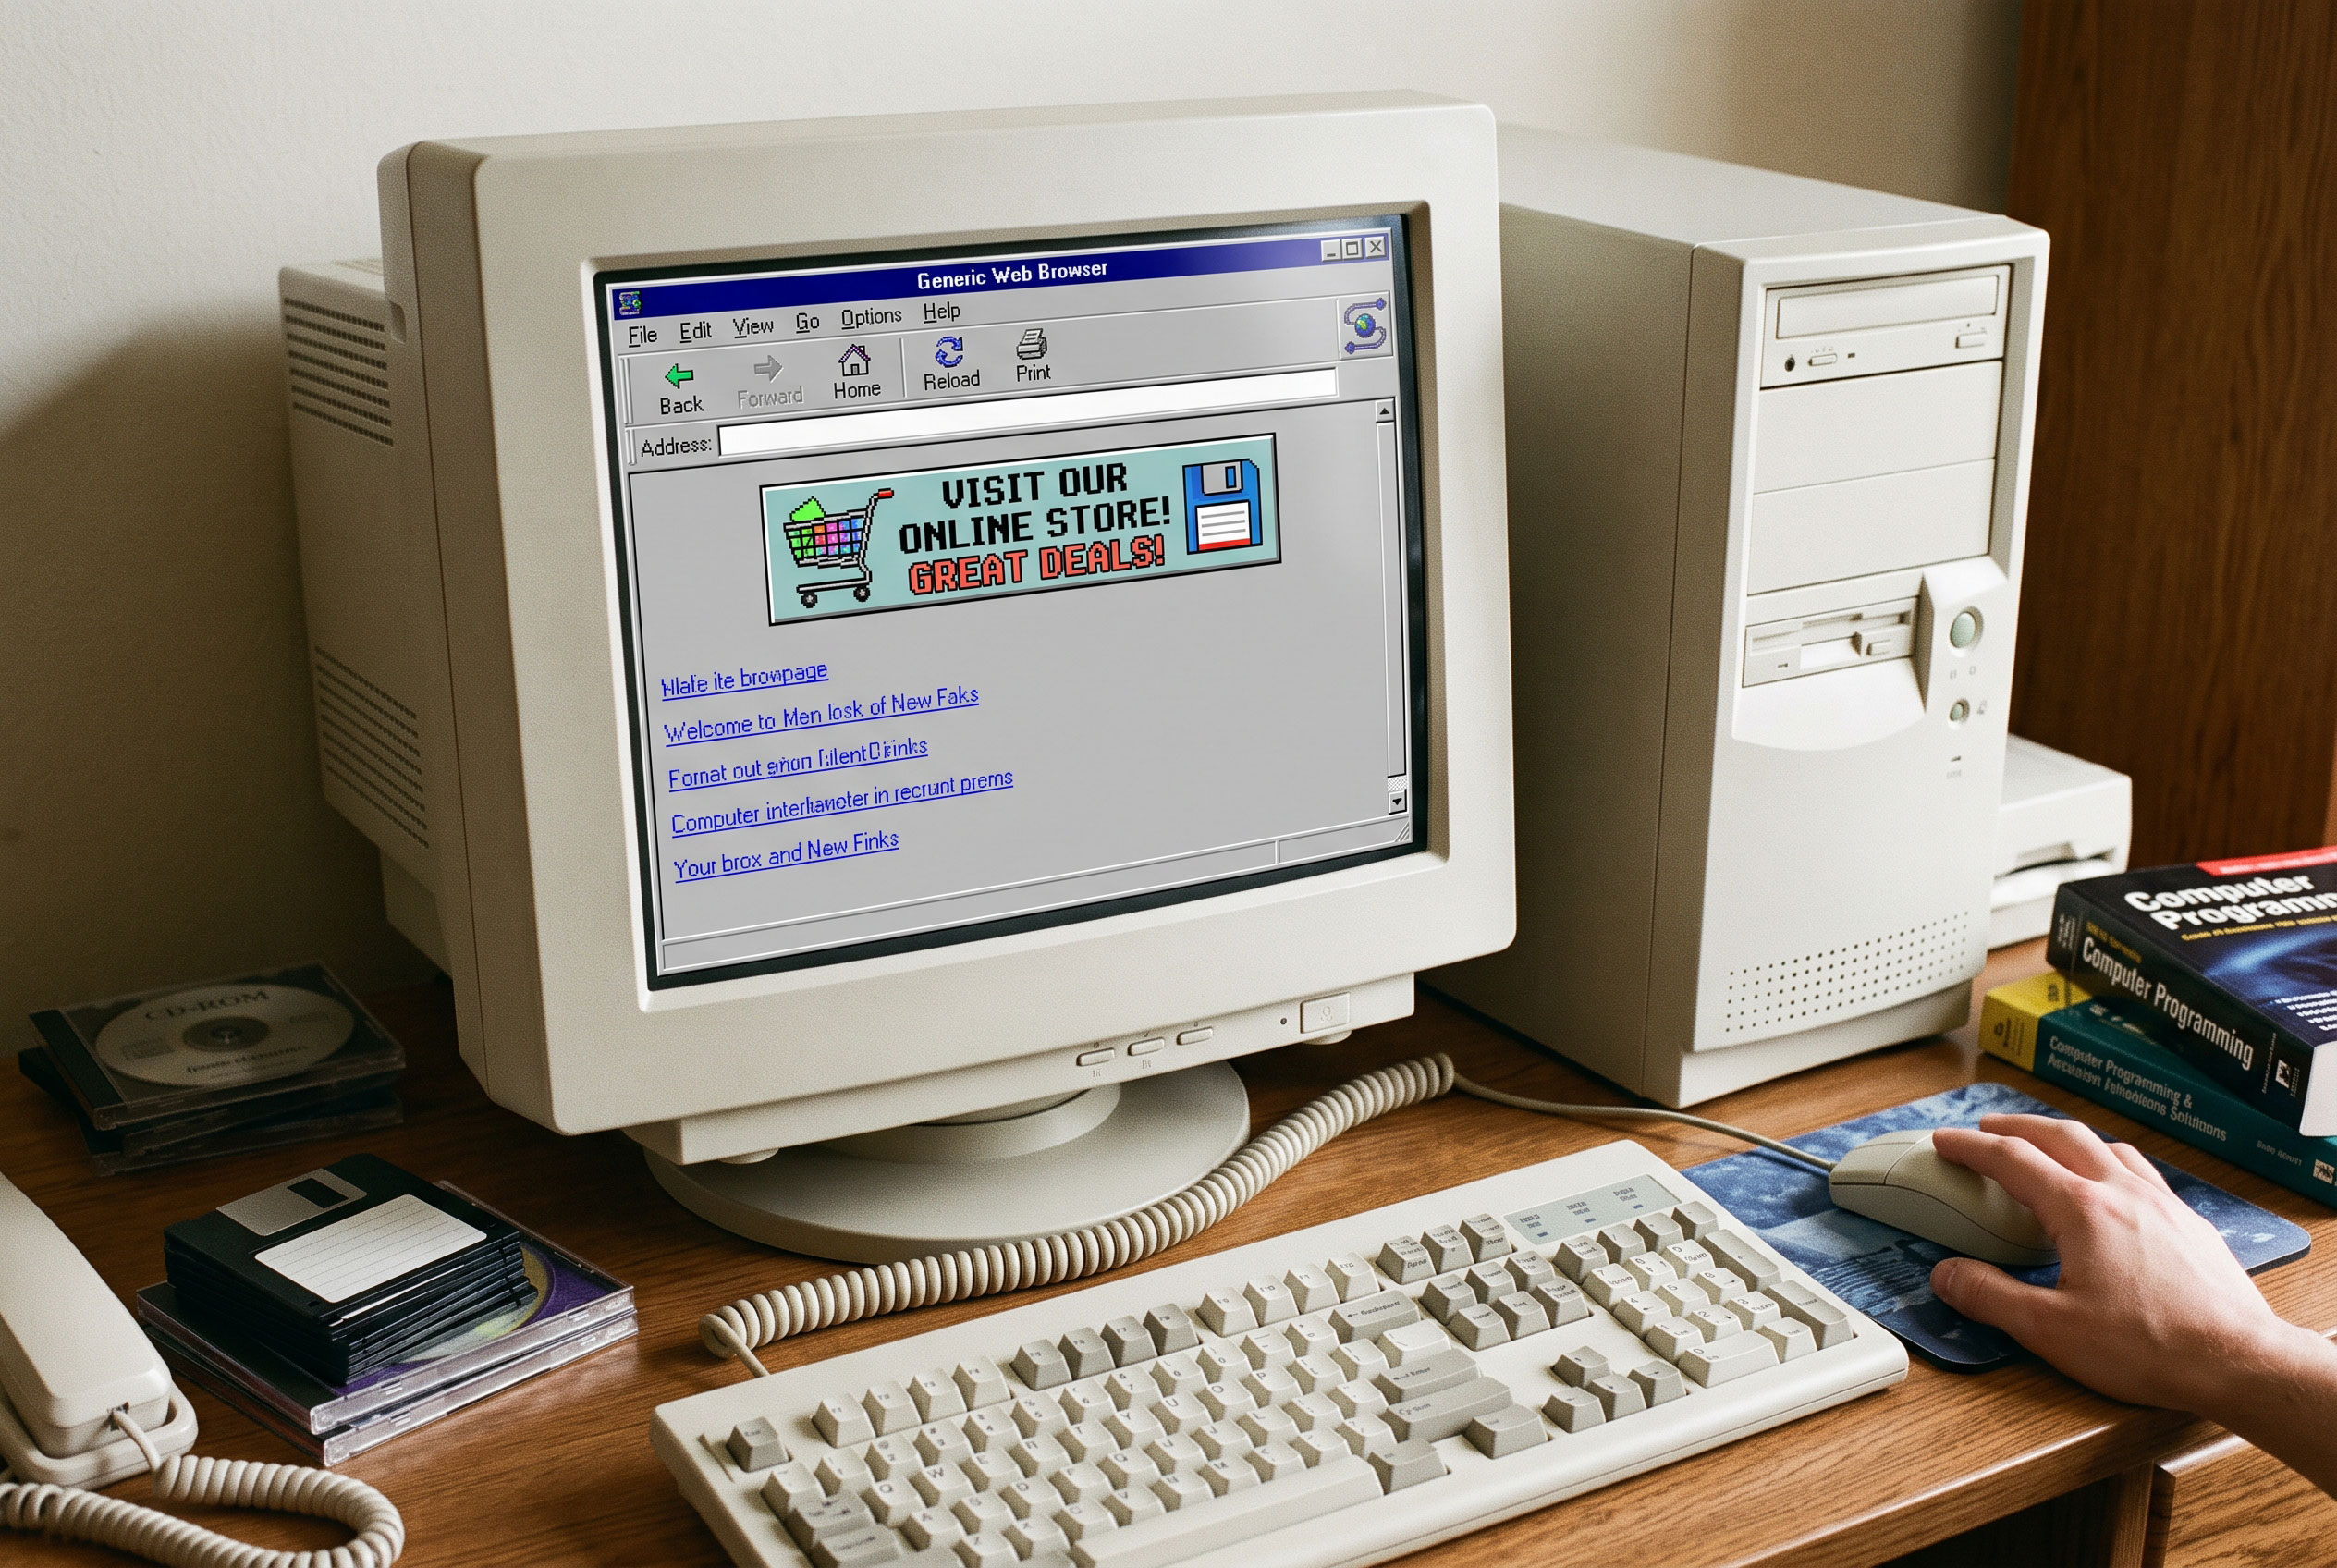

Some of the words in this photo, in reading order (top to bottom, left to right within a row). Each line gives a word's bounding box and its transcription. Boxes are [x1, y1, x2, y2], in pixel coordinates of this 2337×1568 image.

[916, 270, 986, 290] Generic
[991, 265, 1034, 284] Web
[1038, 261, 1108, 281] Browser
[628, 326, 658, 348] File
[679, 322, 712, 343] Edit
[734, 316, 775, 338] View
[795, 312, 820, 334] Go
[841, 307, 903, 331] Options
[923, 302, 961, 325] Help
[659, 396, 704, 415] Back
[737, 385, 804, 410] Forward
[833, 380, 882, 400] Home
[924, 370, 981, 391] Reload
[1016, 362, 1051, 383] Print
[640, 435, 713, 459] Address:
[941, 471, 1045, 509] VISIT
[1058, 462, 1128, 498] OUR
[899, 512, 1034, 555] ONLINE
[1046, 496, 1171, 539] STORE!
[908, 549, 1028, 596] GREAT
[1039, 533, 1166, 581] DEALS!
[664, 718, 752, 743] Welcome
[757, 713, 776, 731] to
[869, 695, 887, 716] of
[891, 691, 932, 713] New
[936, 685, 980, 706] Faks
[671, 807, 760, 834] Computer
[874, 785, 890, 805] in
[673, 859, 716, 879] Your
[721, 853, 763, 873] brox
[768, 841, 802, 865] and
[807, 839, 848, 860] New
[853, 829, 899, 851] Finks
[2124, 874, 2315, 913] Computer
[2082, 936, 2153, 1000] Computer
[2153, 982, 2255, 1071] Programming
[2049, 1035, 2105, 1070] Computer
[2105, 1059, 2182, 1107] Programming
[2183, 1093, 2194, 1109] &
